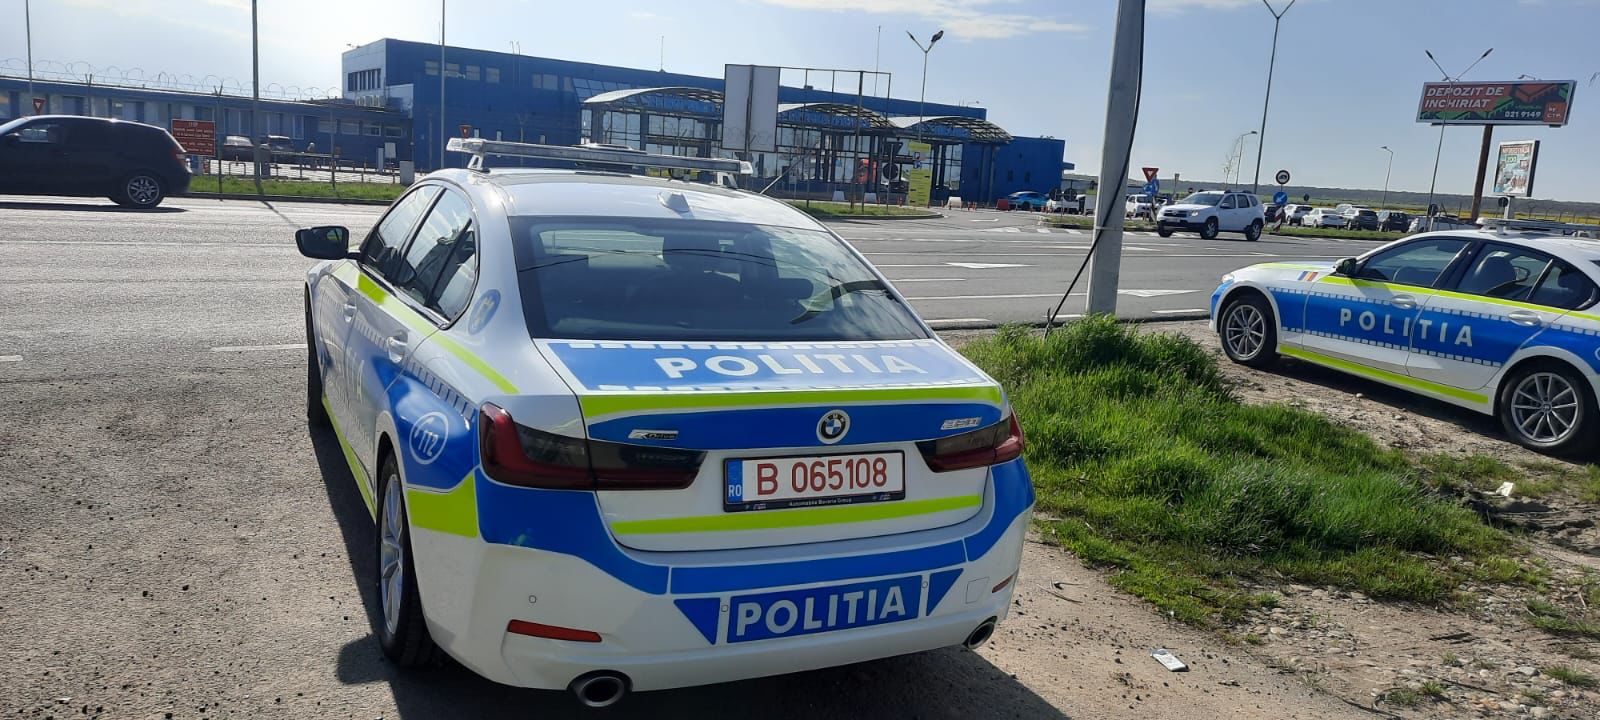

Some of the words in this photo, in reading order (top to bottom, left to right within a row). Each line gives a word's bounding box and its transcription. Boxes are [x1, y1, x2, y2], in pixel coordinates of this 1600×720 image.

[1424, 99, 1489, 108] INCHIRIAT
[1426, 87, 1484, 97] DEPOZIT
[1486, 86, 1505, 96] DE
[1340, 308, 1473, 347] POLITIA
[654, 354, 928, 378] POLITIA
[418, 430, 439, 456] 112
[757, 463, 778, 496] B
[791, 457, 887, 492] 065108
[728, 484, 742, 497] RO
[736, 585, 906, 636] POLITIA
